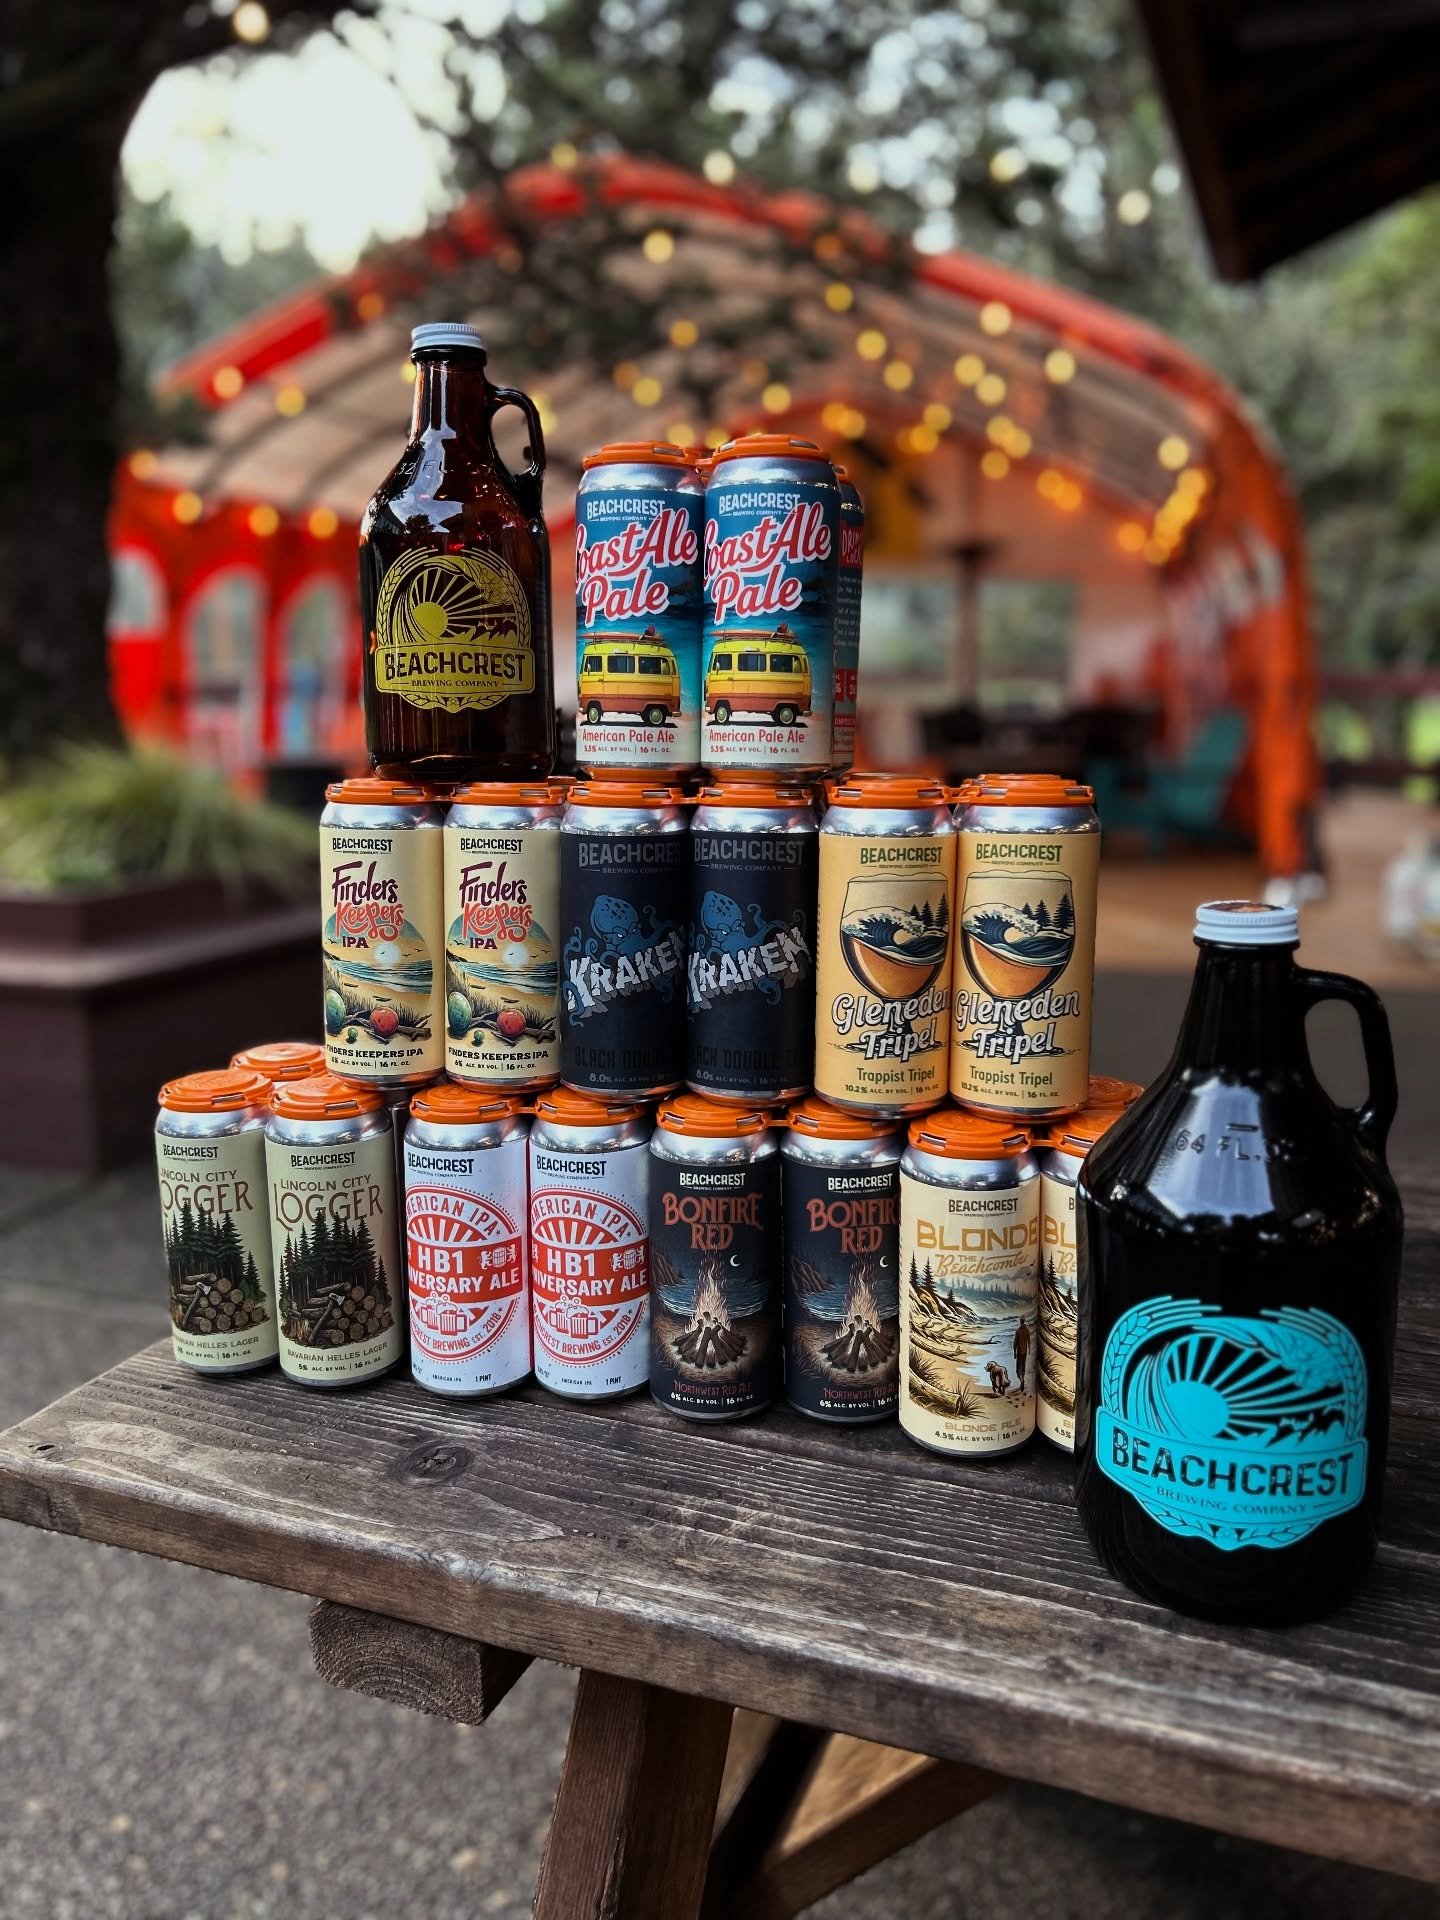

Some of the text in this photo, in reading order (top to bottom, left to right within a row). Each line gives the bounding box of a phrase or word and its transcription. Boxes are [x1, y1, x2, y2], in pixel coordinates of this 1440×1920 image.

[587, 498, 665, 520] BEACHCREST
[719, 492, 800, 515] BEACHCREST
[582, 567, 670, 628] Pale
[711, 562, 803, 626] Pale
[385, 651, 526, 681] BEACHCREST
[411, 680, 499, 688] BREWING COMPANY
[583, 729, 675, 743] American Pale Ale
[709, 729, 805, 743] American Pale Ale
[332, 837, 393, 852] BEACHCREST
[460, 838, 523, 852] BEACHCREST
[578, 842, 681, 867] BEACHCRES
[694, 838, 805, 866] BEACHCREST
[860, 846, 943, 864] BEACHCREST
[976, 843, 1062, 863] BEACHCREST
[710, 863, 782, 872] BREWING COMPANY
[332, 861, 398, 907] Finders
[459, 861, 528, 908] Finders
[336, 901, 405, 941] Keepers
[462, 902, 533, 942] Keepers
[342, 936, 369, 948] IPA
[470, 938, 498, 949] IPA
[831, 985, 949, 1034] Gleneden
[954, 986, 1080, 1032] Gleneden
[859, 1018, 938, 1062] Tripel
[972, 1022, 1056, 1065] Tripel
[356, 1048, 424, 1058] KEEPERS IPA
[481, 1052, 531, 1061] KEEPERS
[533, 1050, 549, 1059] IPA
[857, 1066, 935, 1084] Trappist Tripel
[970, 1065, 1052, 1088] Trappist Tripel
[845, 1084, 867, 1093] 10.2%
[961, 1082, 978, 1092] 10.2%
[163, 1144, 219, 1158] BEACHCREST
[1175, 1128, 1206, 1154] 64
[291, 1152, 355, 1167] BEACHCREST
[408, 1151, 474, 1174] BEACHCREST
[536, 1154, 607, 1176] BEACHCREST
[206, 1169, 237, 1182] CITY
[281, 1174, 372, 1191] LINCOLN CITY
[680, 1172, 746, 1186] BEACHCREST
[827, 1173, 893, 1190] BEACHCREST
[161, 1180, 253, 1217] OGGER
[274, 1185, 383, 1231] LOGGER
[948, 1198, 1019, 1213] BEACHCREST
[407, 1195, 499, 1236] MERICAN IPA
[662, 1192, 764, 1231] BONFIRE
[602, 1209, 630, 1238] IPA
[917, 1214, 1038, 1251] BLONDE
[690, 1222, 734, 1251] RED
[841, 1226, 883, 1255] RED
[418, 1245, 463, 1274] HB1
[547, 1248, 595, 1277] HB1
[958, 1254, 977, 1262] THE
[490, 1267, 519, 1290] ALE
[532, 1268, 647, 1296] NIVERSARY ALE
[197, 1341, 227, 1349] HELLES
[230, 1336, 259, 1347] LAGER
[432, 1337, 470, 1352] BREWING
[482, 1311, 501, 1332] 2018
[562, 1340, 601, 1355] BREWING
[613, 1315, 632, 1336] 2018
[288, 1342, 388, 1361] BAVARIAN HELLES LAGER
[355, 1361, 363, 1369] 16
[479, 1374, 491, 1382] PINT
[610, 1376, 621, 1384] PINT
[671, 1391, 681, 1401] 6%
[726, 1397, 735, 1405] 16
[820, 1399, 831, 1408] 6%
[877, 1398, 885, 1406] 16
[935, 1430, 954, 1441] 4.5%
[945, 1416, 1021, 1433] BLONDE ALE
[1054, 1427, 1071, 1439] 4.5%
[1112, 1425, 1354, 1497] BEACHCREST
[1156, 1486, 1306, 1515] BREWING COMPANY
